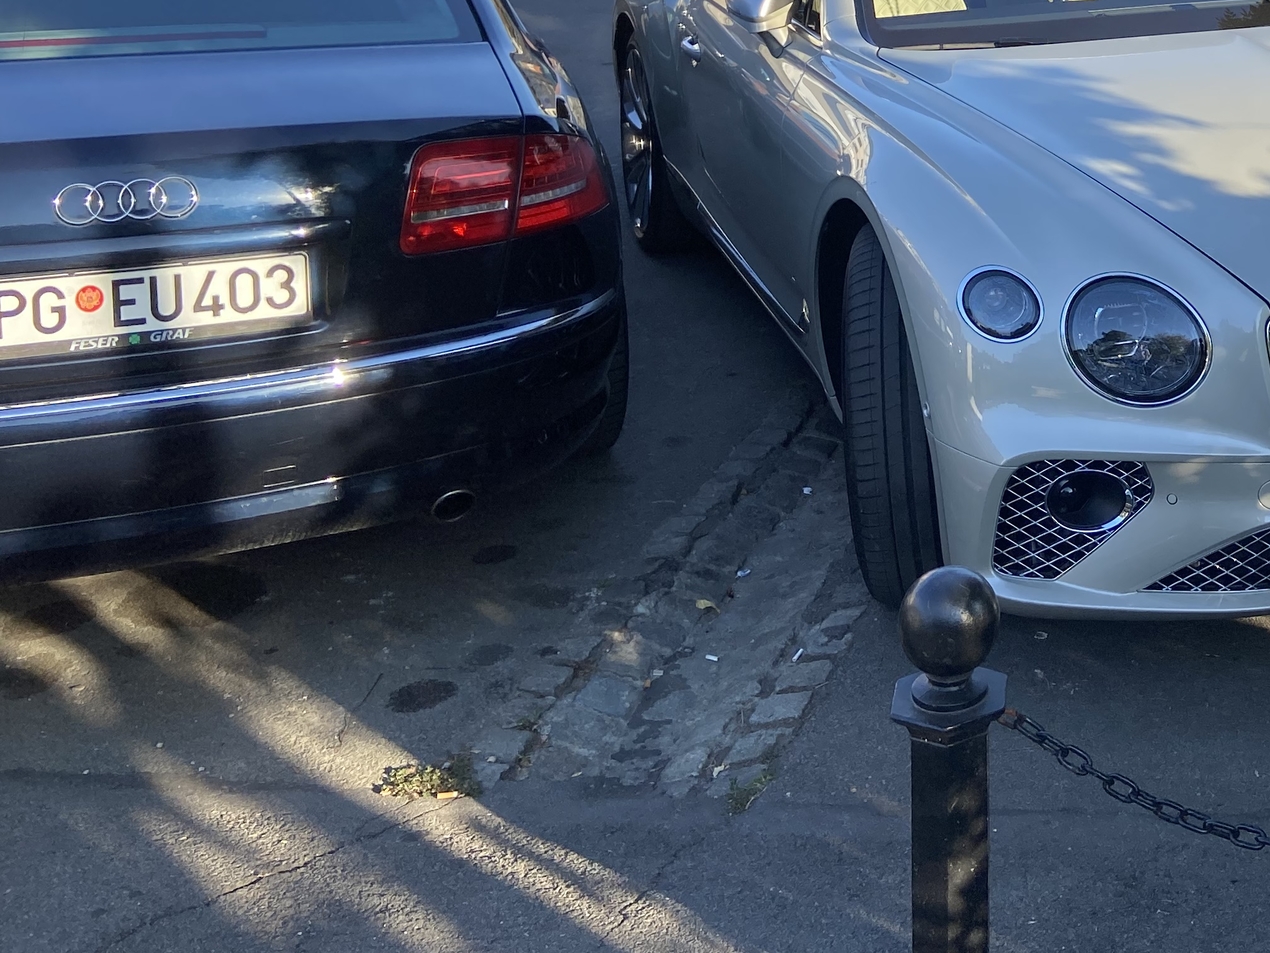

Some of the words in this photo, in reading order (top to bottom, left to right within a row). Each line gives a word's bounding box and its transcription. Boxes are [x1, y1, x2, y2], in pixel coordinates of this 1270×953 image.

[0, 285, 67, 339] PG
[69, 335, 119, 352] FESER
[150, 327, 194, 343] GRAF
